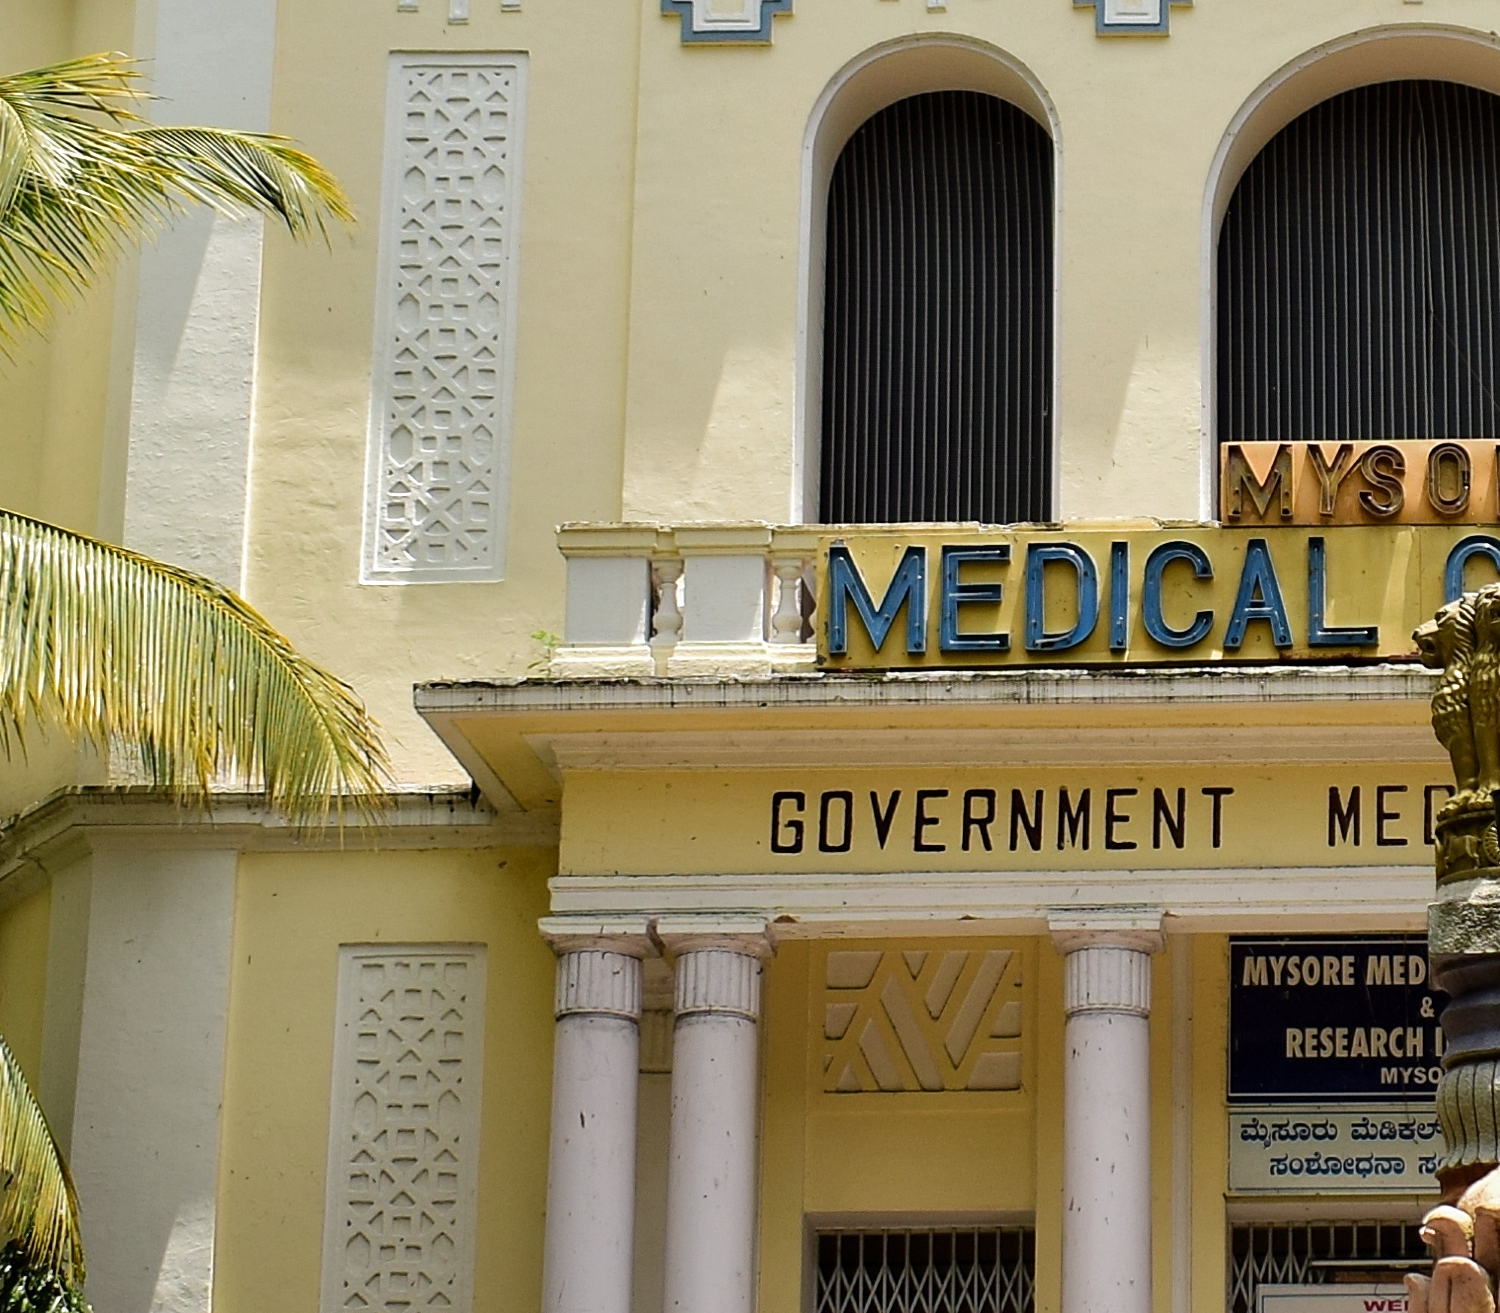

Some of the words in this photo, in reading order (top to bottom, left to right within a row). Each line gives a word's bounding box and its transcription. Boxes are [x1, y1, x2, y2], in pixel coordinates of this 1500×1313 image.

[825, 536, 1380, 656] MEDICAL
[770, 786, 1236, 856] GOVERNMENT
[1243, 955, 1355, 986] MYSORE
[1420, 996, 1435, 1018] &
[1286, 1027, 1424, 1058] RESEARCH
[1381, 1067, 1443, 1085] MYSO
[1240, 1117, 1338, 1148] ಮೈಸೂರು
[1269, 1152, 1405, 1179] ಸಂಶೋಧನಾ
